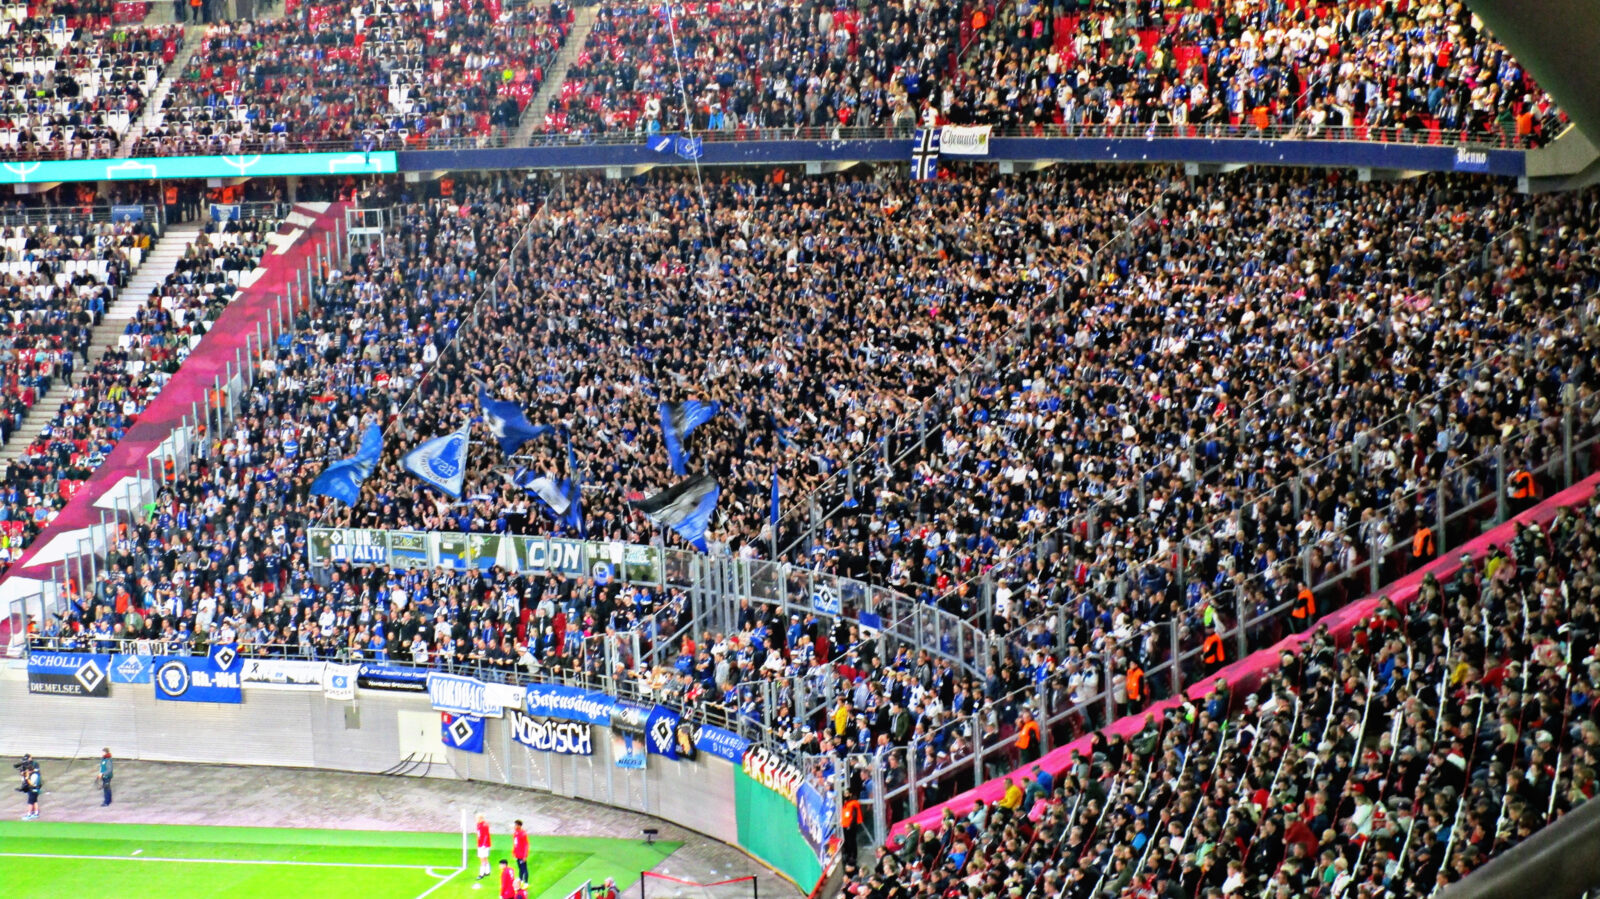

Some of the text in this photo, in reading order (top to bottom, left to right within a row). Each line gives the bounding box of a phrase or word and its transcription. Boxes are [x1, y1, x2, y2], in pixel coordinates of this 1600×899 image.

[1457, 147, 1486, 164] Benno
[29, 654, 82, 668] SCHOLLI
[30, 683, 81, 694] DIEMELSEE
